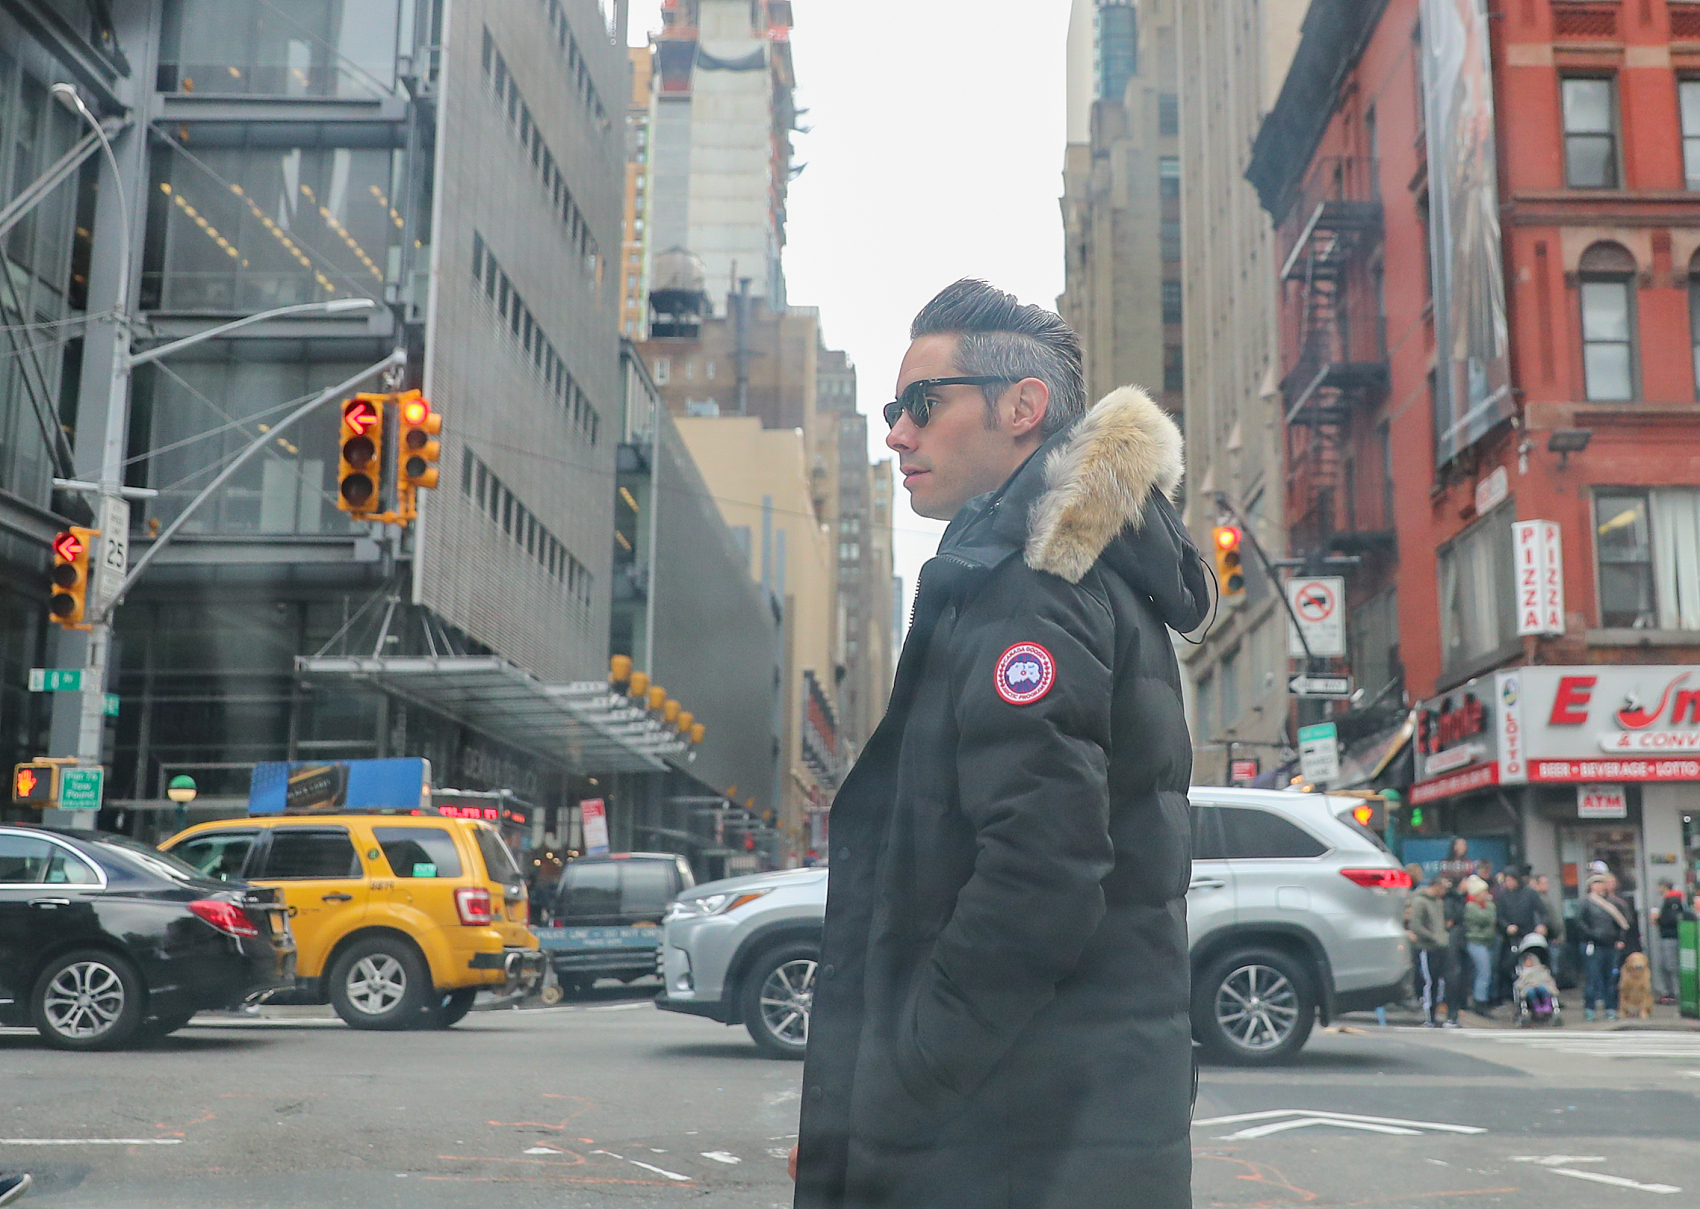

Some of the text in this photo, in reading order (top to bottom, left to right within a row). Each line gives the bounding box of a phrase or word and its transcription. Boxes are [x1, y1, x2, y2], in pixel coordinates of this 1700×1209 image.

[107, 538, 124, 568] 25
[1521, 527, 1539, 627] PIZZA
[1546, 526, 1559, 626] PIZZA
[1549, 676, 1597, 725] E
[1506, 712, 1520, 774] LOTTO
[1539, 761, 1699, 778] BEER BEVERAGE LOTTO
[1583, 795, 1622, 807] ATM
